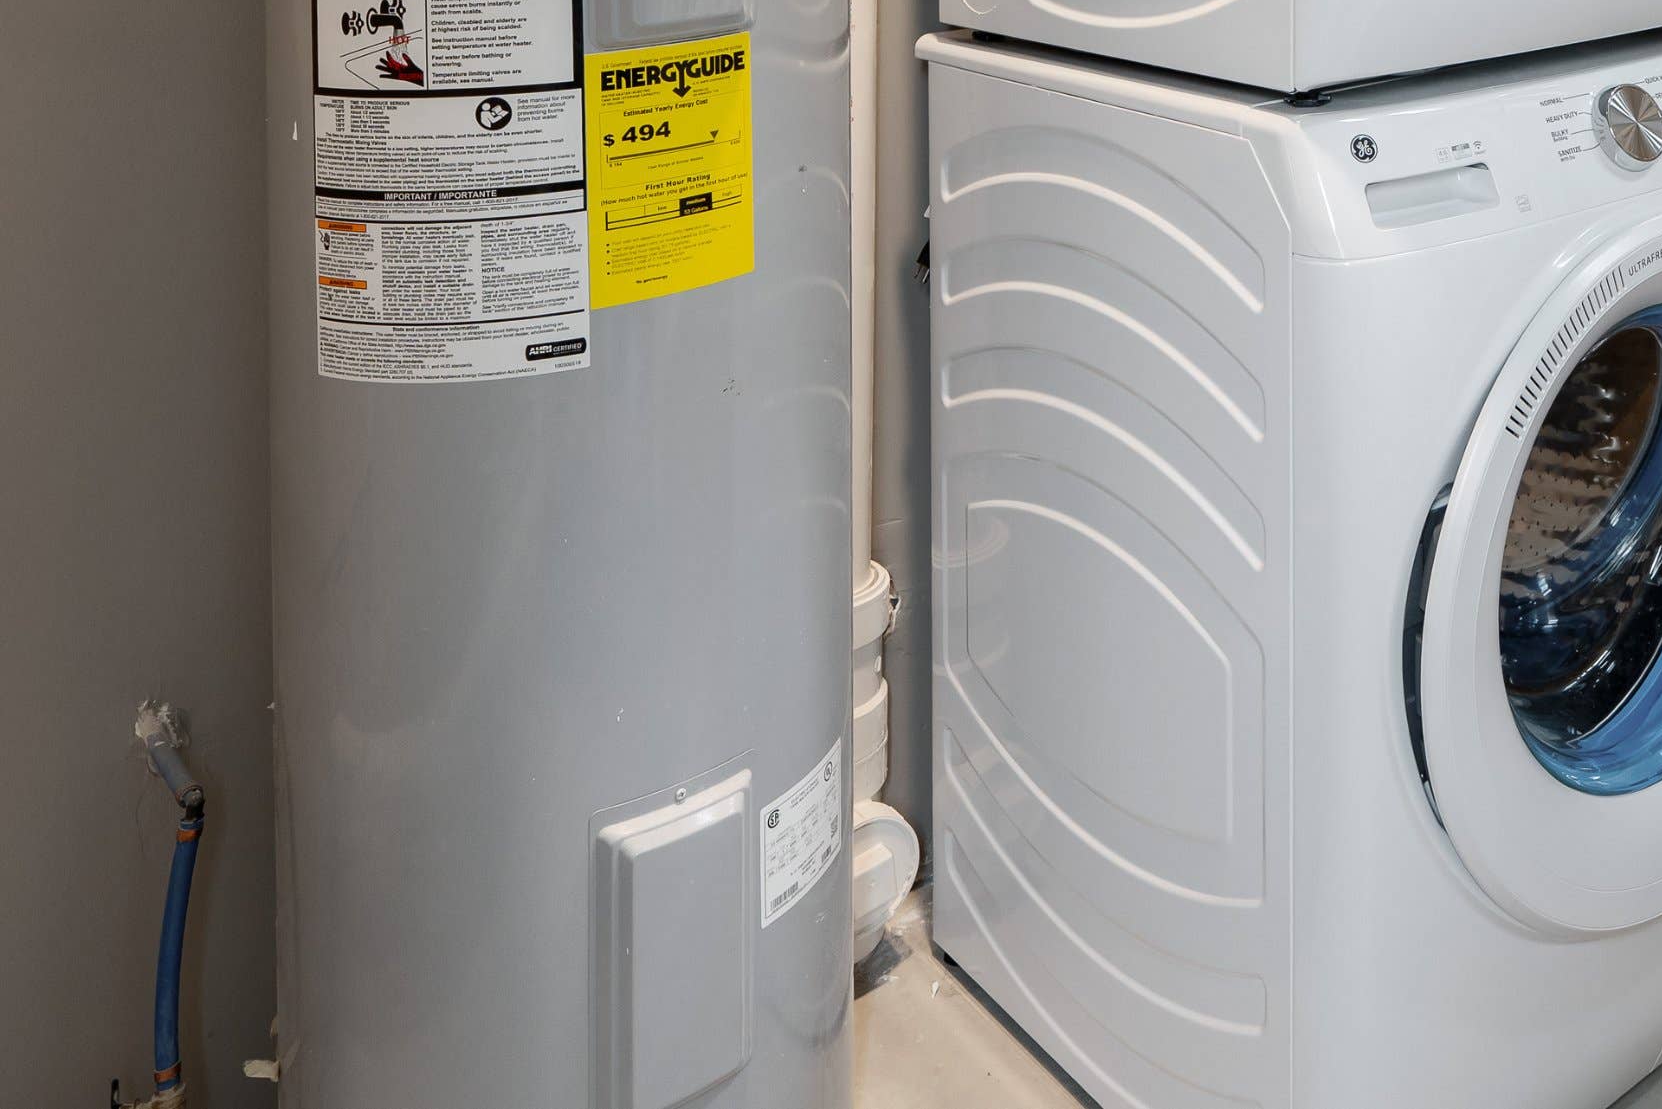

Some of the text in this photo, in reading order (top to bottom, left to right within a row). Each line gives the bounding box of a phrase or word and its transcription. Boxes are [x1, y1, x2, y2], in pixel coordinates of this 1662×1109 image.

[601, 51, 745, 91] ENERGYGUIDE
[1645, 76, 1659, 84] QUICK
[624, 107, 653, 116] Estimated
[656, 103, 673, 112] Yearly
[675, 100, 694, 110] Energy
[1540, 98, 1563, 107] NORMAL
[1546, 111, 1578, 123] HEAVY DUTY
[603, 121, 671, 147] $ 494
[1551, 129, 1568, 137] BULKY
[1558, 146, 1582, 157] SANITIZE
[666, 179, 684, 187] Hour
[687, 174, 710, 182] Rating
[384, 192, 431, 200] IMPORTANT
[439, 190, 497, 198] IMPORTANTE
[529, 343, 582, 355] AHRI CERTIFIED
